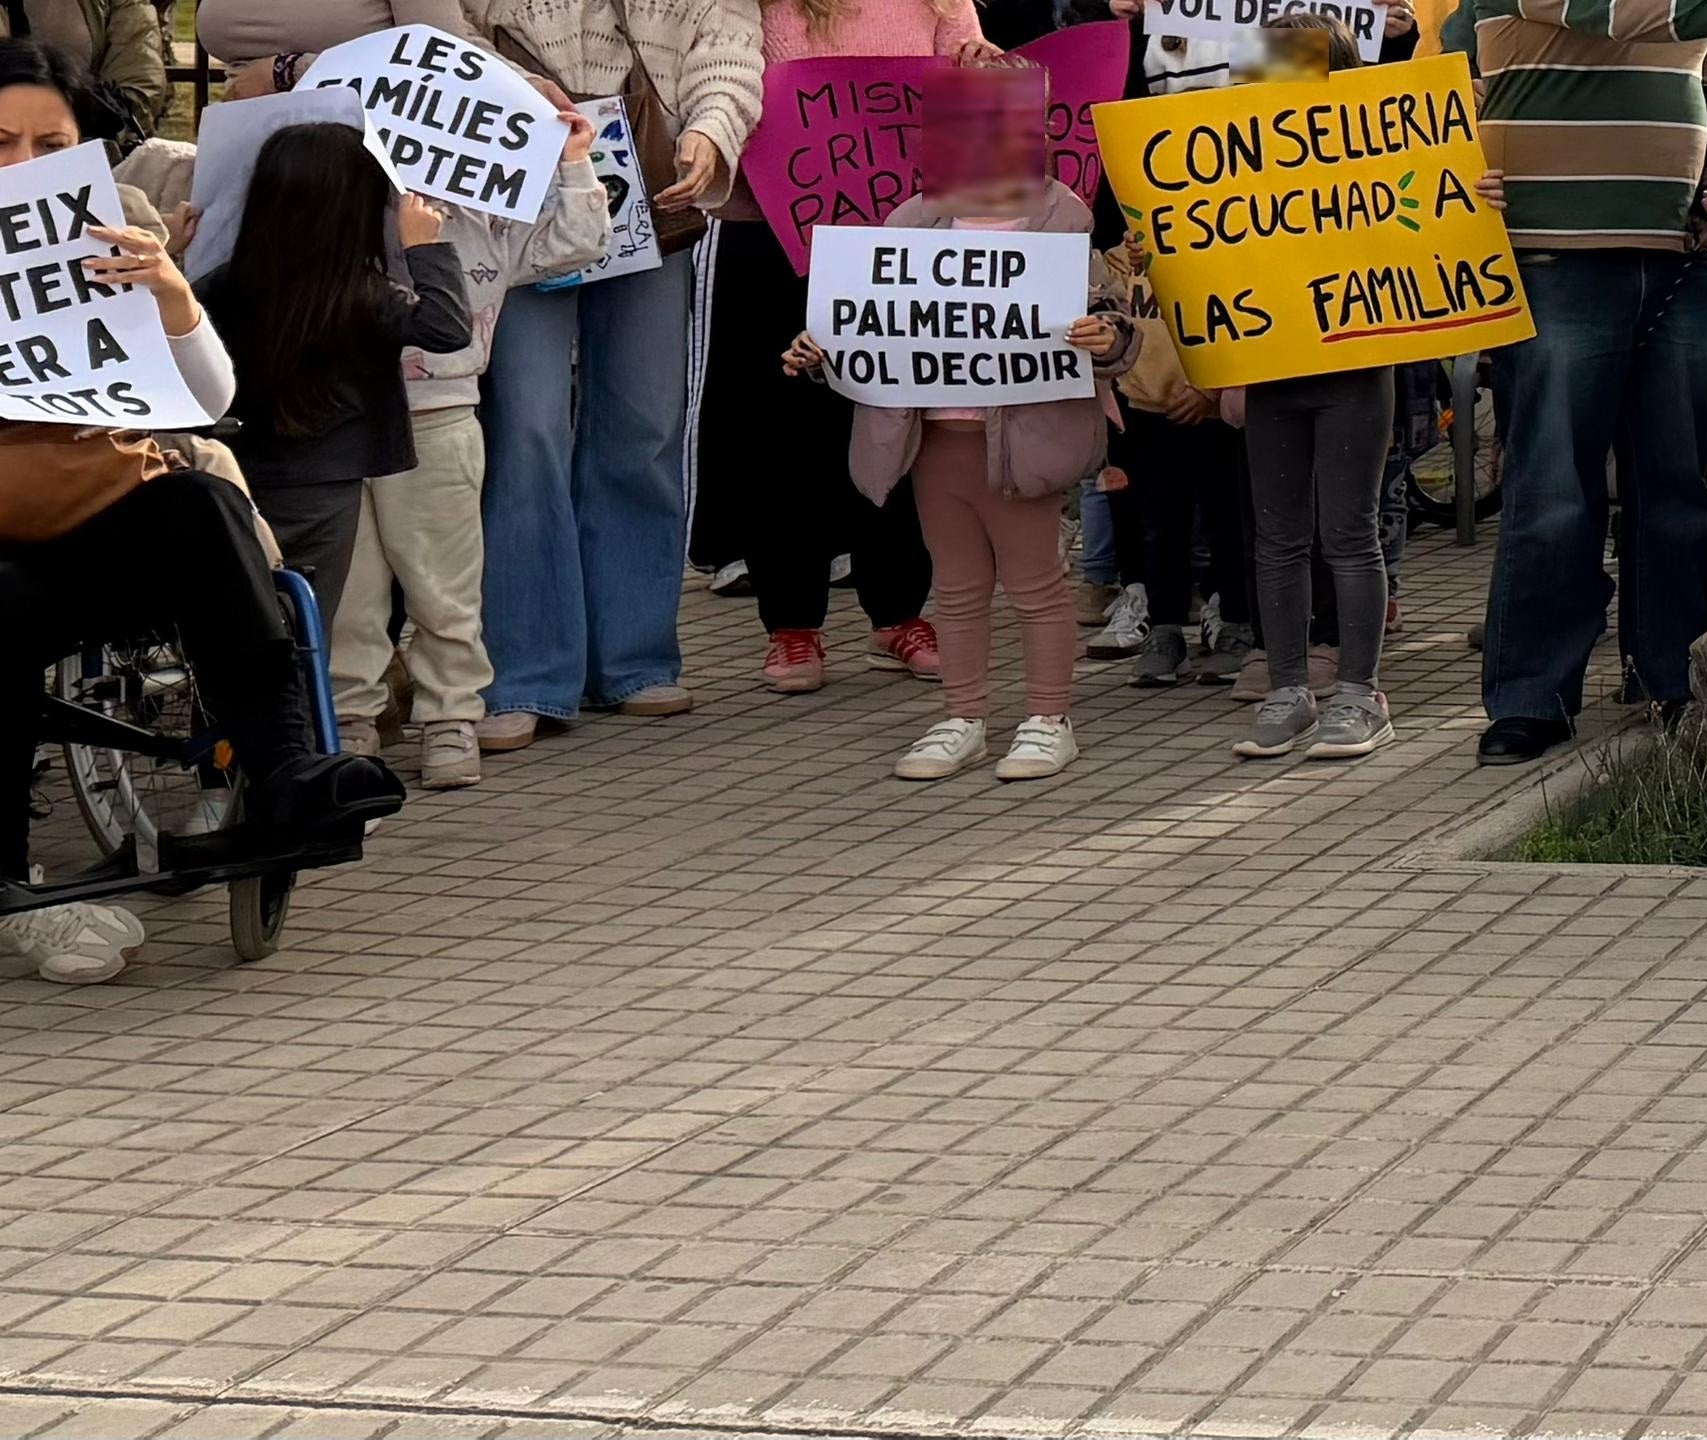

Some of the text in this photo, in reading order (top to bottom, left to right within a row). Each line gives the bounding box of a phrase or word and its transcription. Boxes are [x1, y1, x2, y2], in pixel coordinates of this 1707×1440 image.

[389, 33, 487, 81] LES
[316, 73, 536, 151] MÍLIES
[1143, 88, 1474, 191] CONSELLERIA
[1, 184, 107, 255] EIX
[1152, 168, 1476, 254] ESCUCHAD A
[872, 247, 1026, 288] EL CEIP
[1174, 253, 1516, 348] LAS FAMILIAS
[0, 318, 129, 387] ER A
[833, 299, 1051, 340] PALMERAL
[8, 381, 151, 417] TOTS
[821, 350, 1081, 386] VOL DECIDIR
